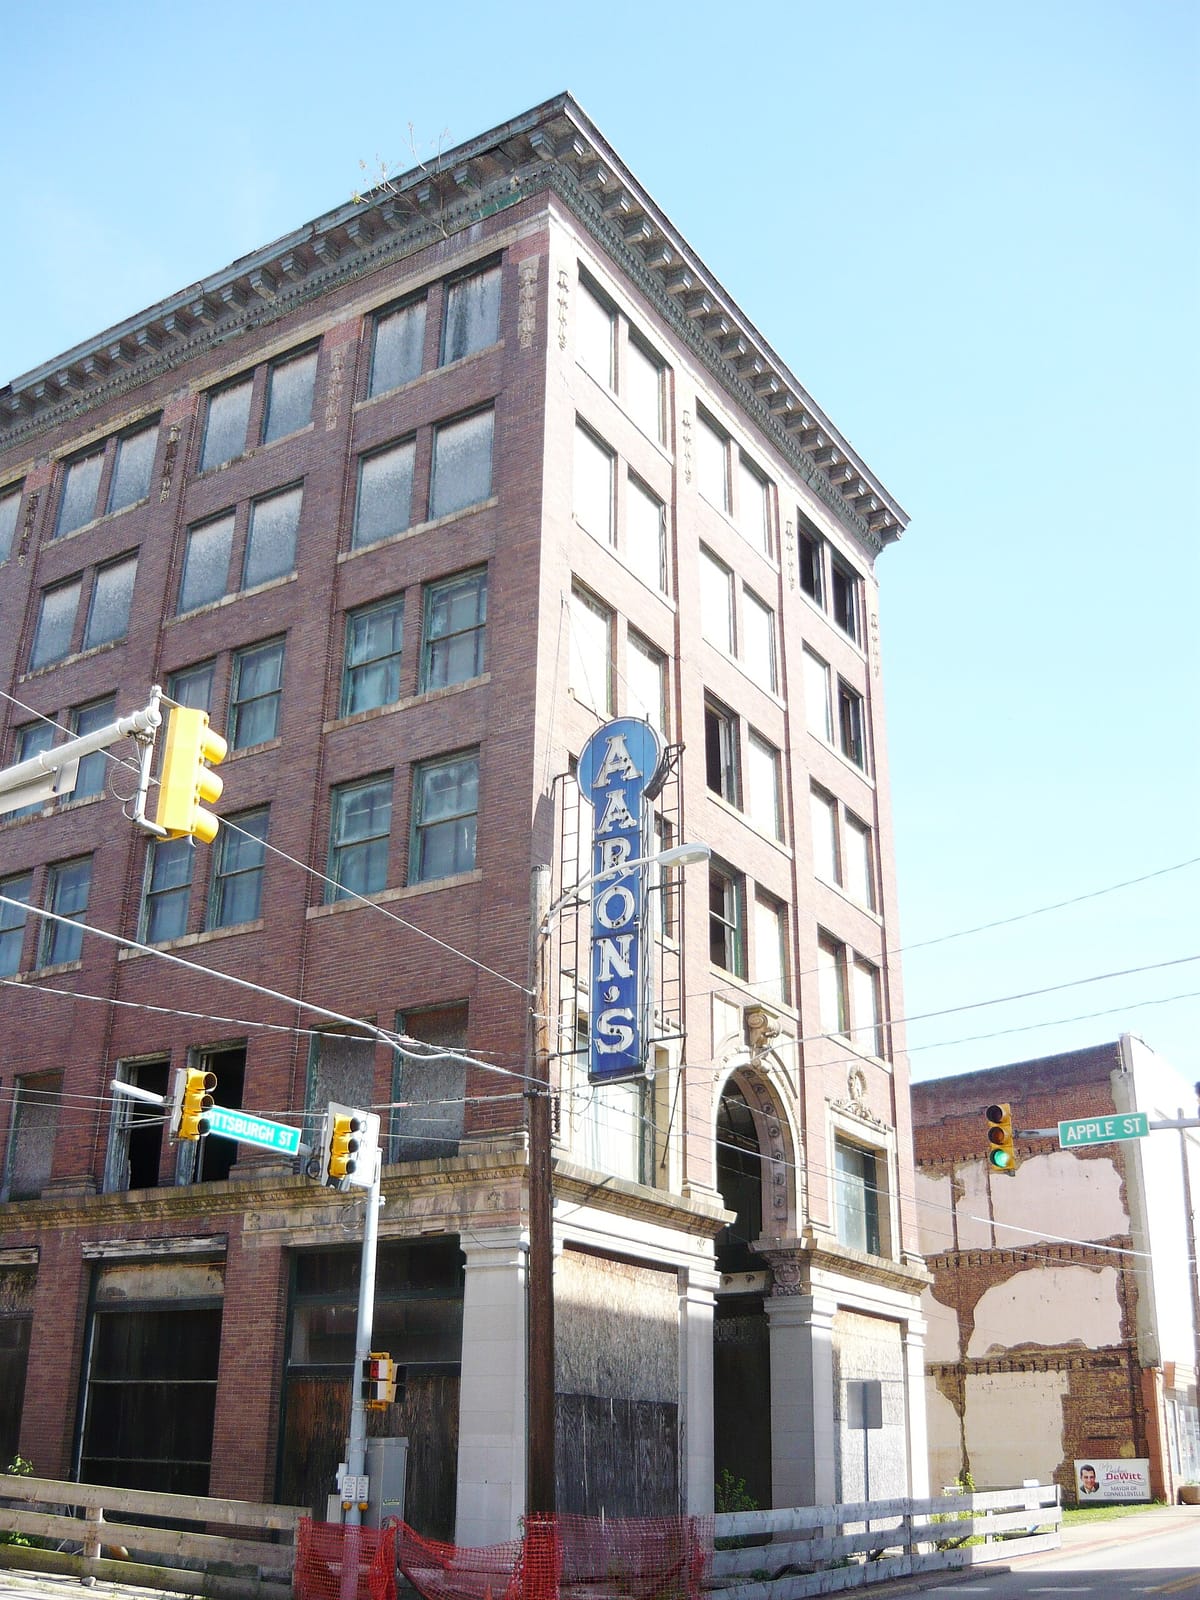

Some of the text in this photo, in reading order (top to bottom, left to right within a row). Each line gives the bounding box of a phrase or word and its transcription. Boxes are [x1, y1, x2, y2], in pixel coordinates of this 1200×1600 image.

[592, 733, 643, 1054] AARON'S
[279, 1130, 294, 1147] ST
[1066, 1117, 1142, 1142] APPLE ST
[1106, 1472, 1142, 1480] DeWitt
